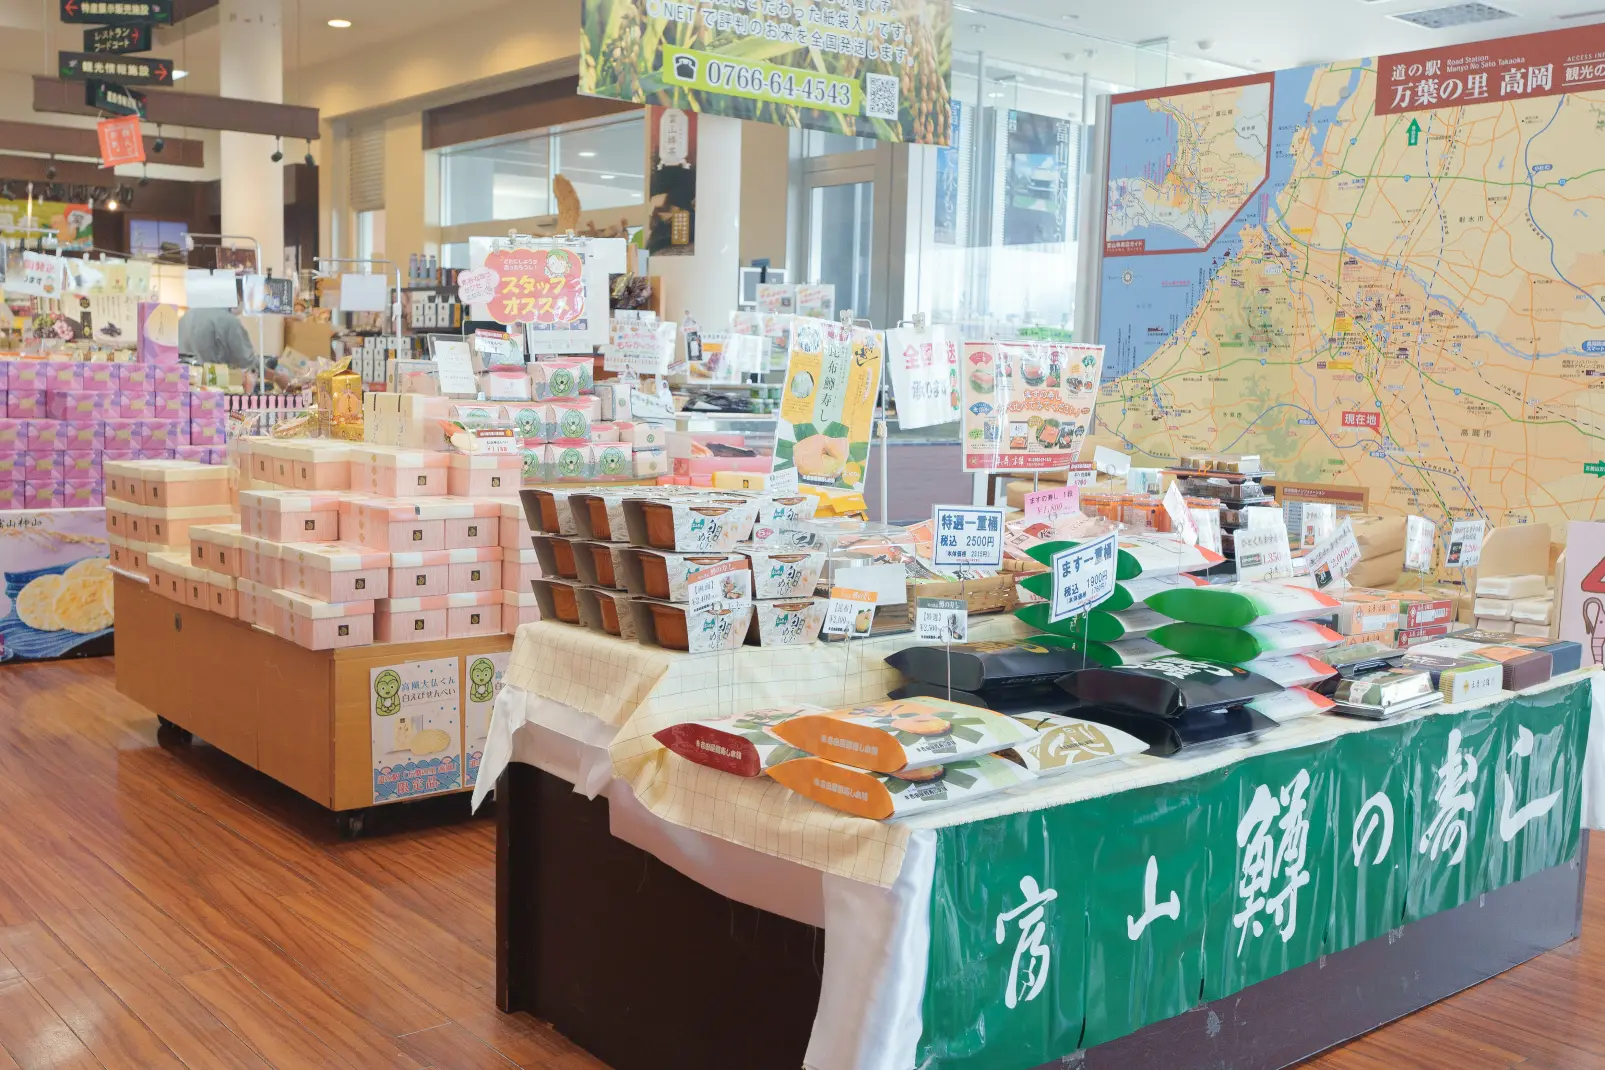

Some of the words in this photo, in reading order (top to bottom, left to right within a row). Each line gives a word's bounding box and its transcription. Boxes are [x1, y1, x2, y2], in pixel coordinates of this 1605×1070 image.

[94, 27, 131, 41] レストラン
[94, 38, 131, 52] フードコート
[1446, 64, 1469, 73] Manyo
[1470, 62, 1480, 70] No
[1481, 60, 1496, 69] Sato
[1498, 56, 1526, 66] Takaoka
[1447, 59, 1464, 67] Road
[1465, 55, 1489, 64] Station
[1567, 53, 1593, 62] ACCESS
[82, 60, 149, 77] 観光情報施設
[1391, 60, 1441, 81] 道の駅
[1565, 65, 1605, 82] 観光の
[708, 60, 851, 106] 0766-64-4543
[1390, 72, 1489, 109] 万葉の里
[1500, 64, 1554, 97] 高岡
[1459, 214, 1485, 223] 射水市
[500, 274, 567, 295] スタッフ
[502, 296, 571, 317] オススメ
[1345, 413, 1377, 426] 現在地
[1460, 428, 1492, 438] 高岡市
[1030, 493, 1059, 504] ますの寿し
[941, 513, 999, 532] 特選一重桶
[940, 534, 958, 547] 税込
[966, 535, 995, 547] 2500円
[1061, 541, 1112, 578] ます一重桶
[1086, 569, 1108, 589] 1900円
[1063, 583, 1079, 598] 税込
[401, 676, 455, 691] 高岡大仏くん
[402, 688, 456, 703] 白えびせんべい
[396, 775, 440, 794] 限定品
